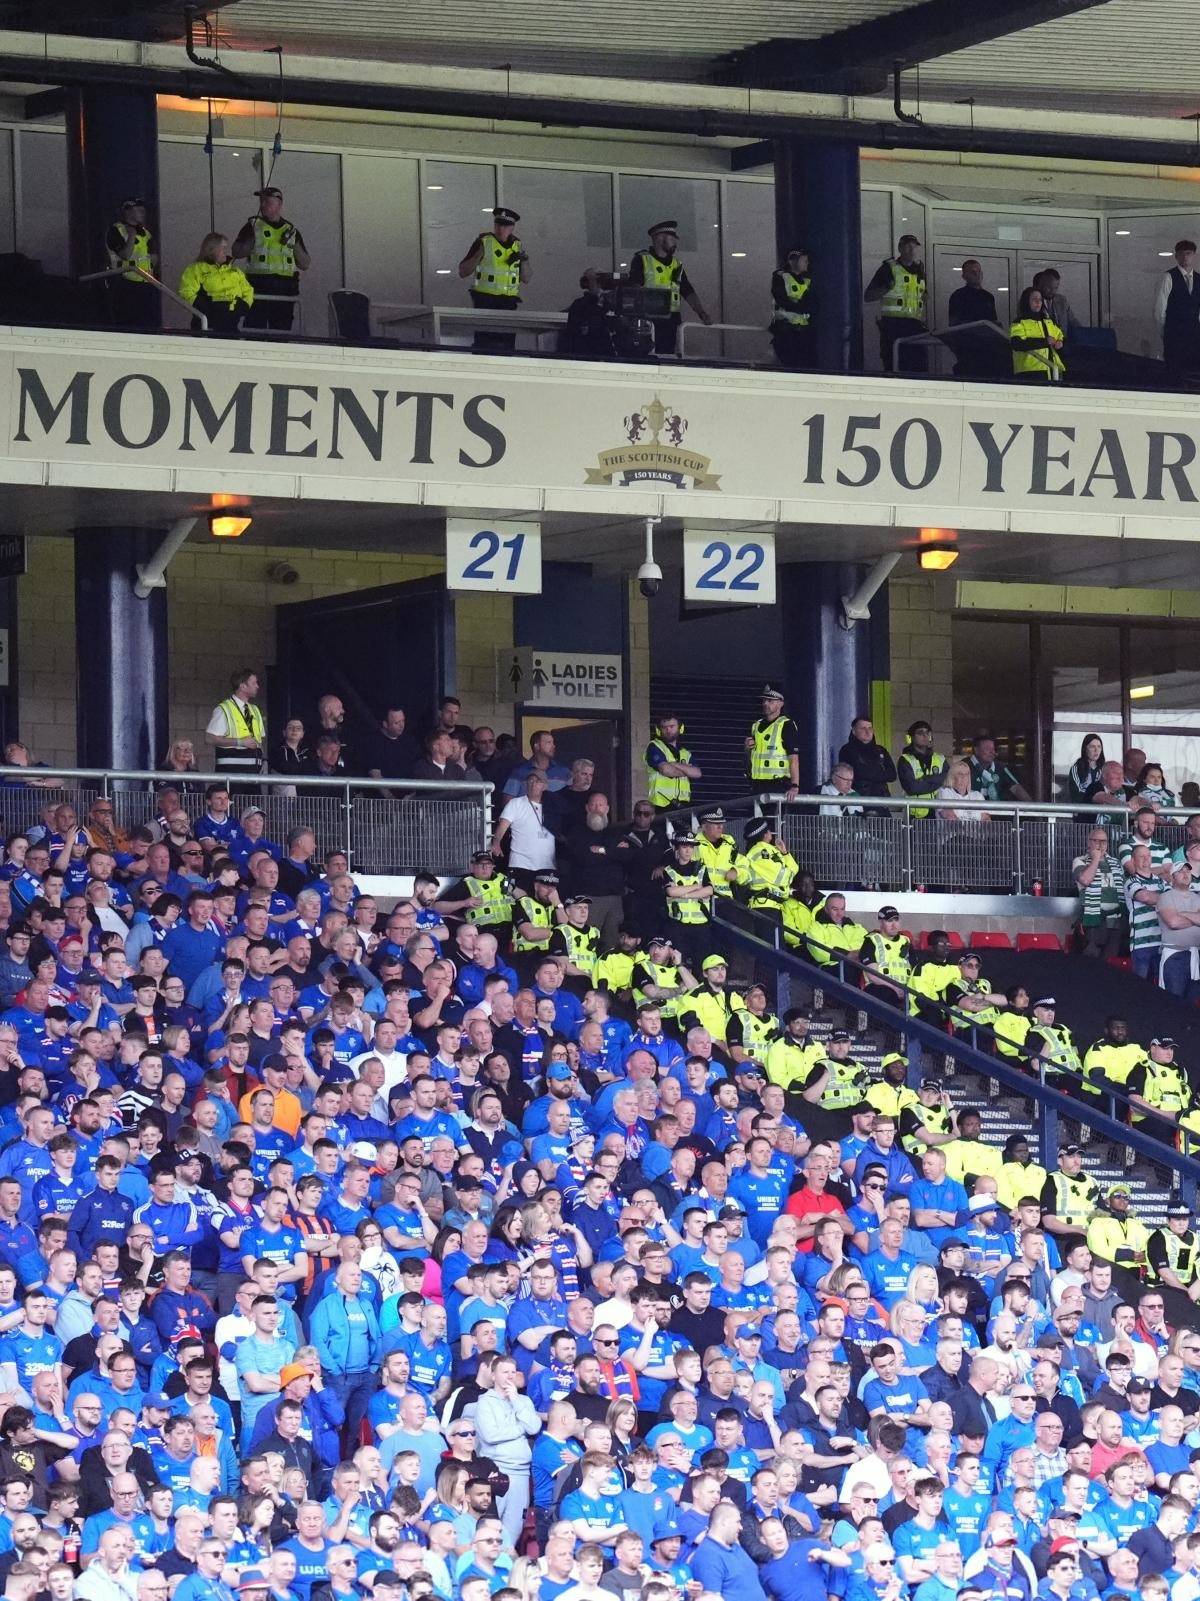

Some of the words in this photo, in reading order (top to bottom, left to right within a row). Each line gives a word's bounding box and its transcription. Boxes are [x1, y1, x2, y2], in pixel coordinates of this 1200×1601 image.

[13, 367, 507, 469] MOMENTS
[603, 454, 626, 467] THE
[628, 452, 681, 466] SCOTTISH
[683, 458, 704, 471] CUP
[801, 413, 943, 491] 150
[634, 471, 647, 480] 150
[648, 471, 672, 481] YEARS
[462, 531, 525, 581] 21
[695, 542, 765, 592] 22
[551, 663, 618, 681] LADIES
[551, 681, 618, 699] TOILET
